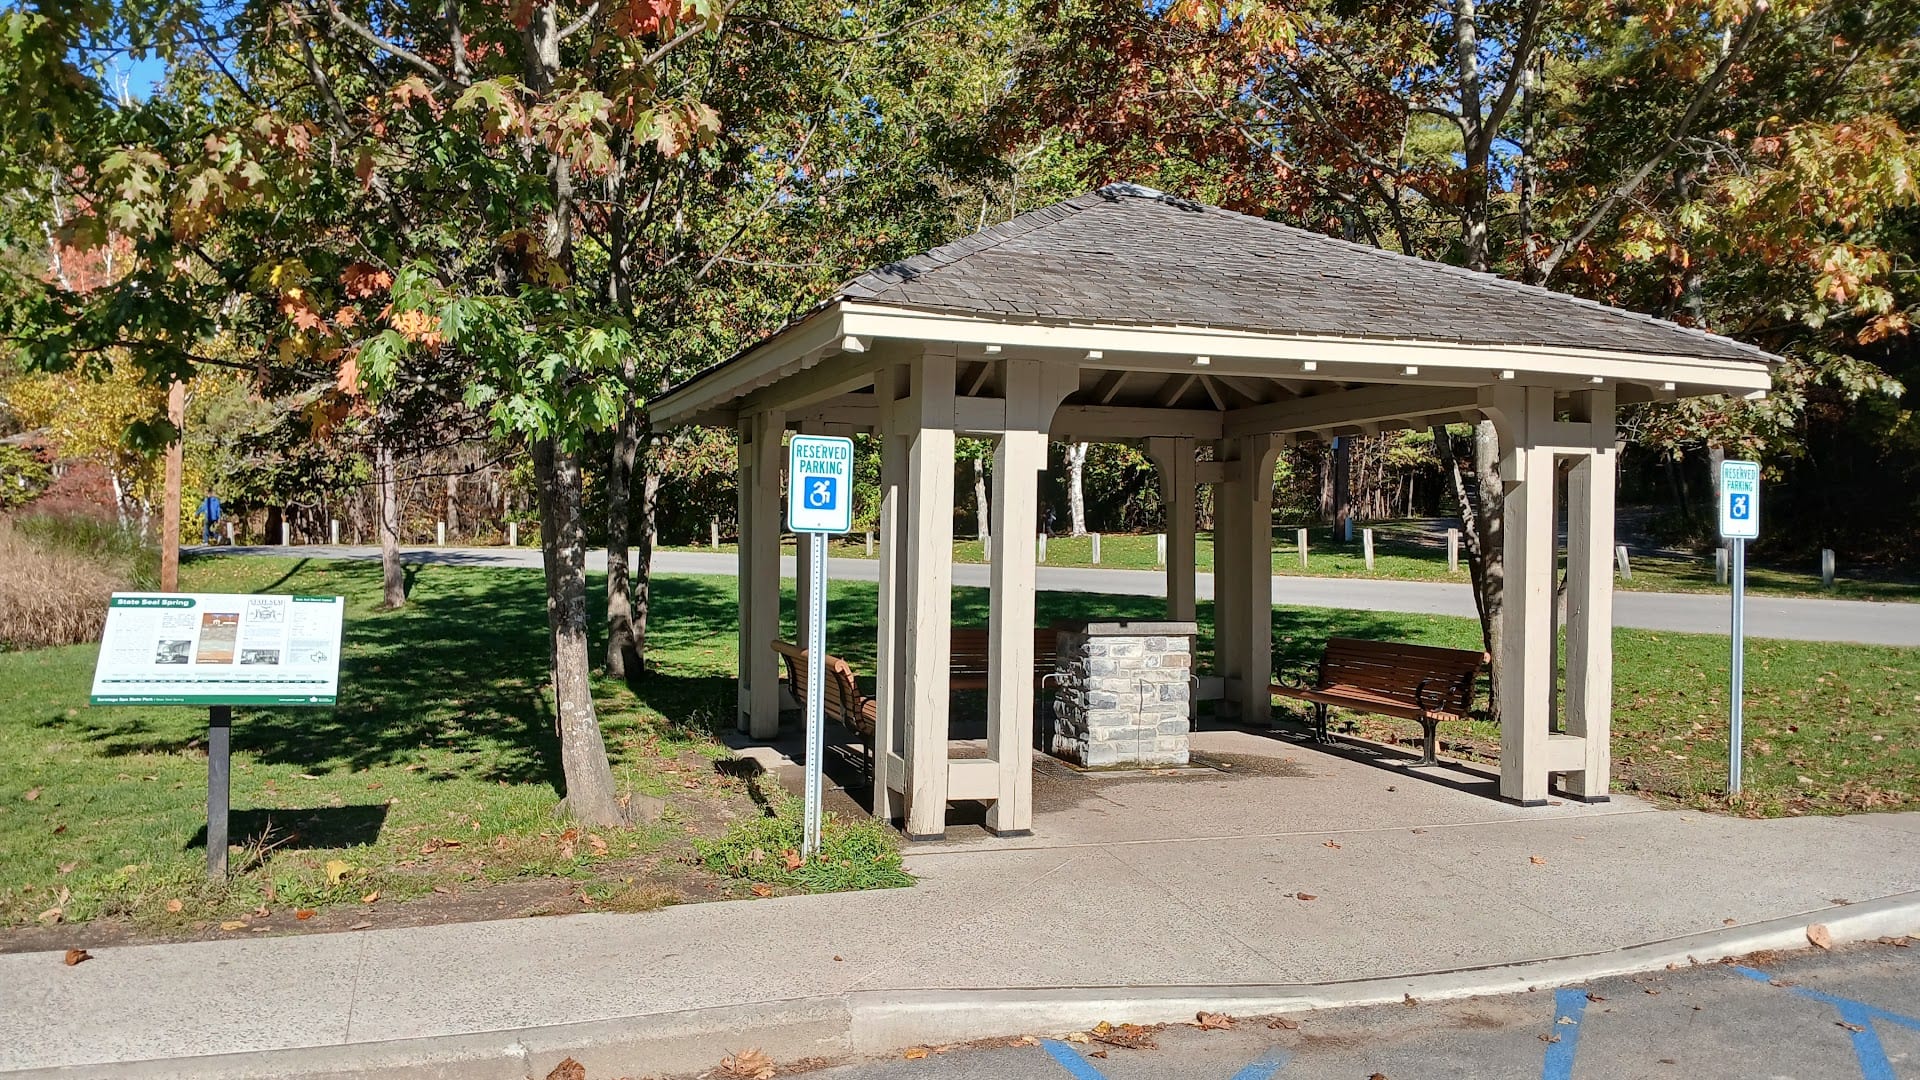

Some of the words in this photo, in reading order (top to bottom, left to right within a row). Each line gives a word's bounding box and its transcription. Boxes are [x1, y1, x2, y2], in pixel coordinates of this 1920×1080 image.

[796, 445, 847, 460] RESERVED
[800, 460, 842, 474] PARKING
[1725, 468, 1756, 480] RESERVED
[1727, 481, 1753, 492] PARKING
